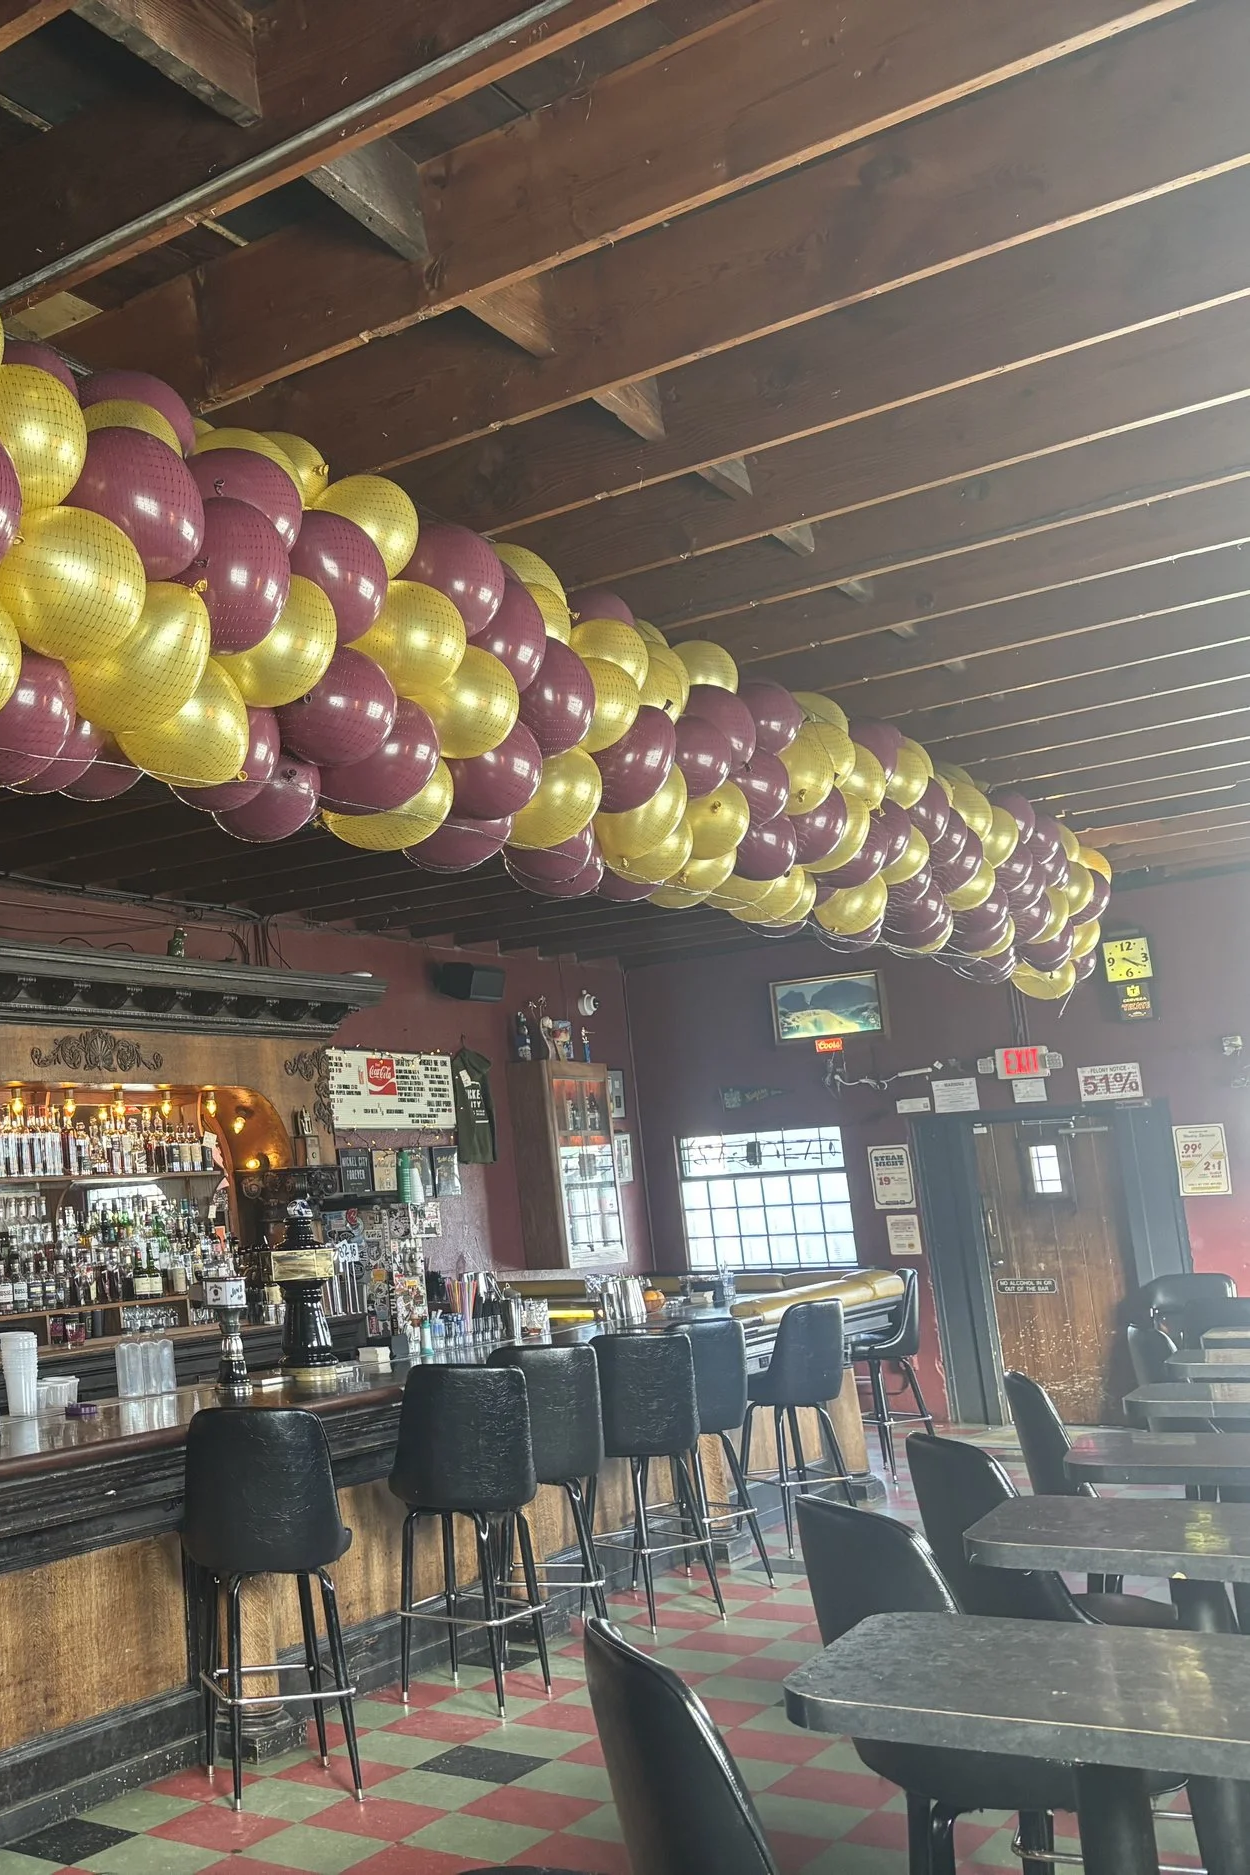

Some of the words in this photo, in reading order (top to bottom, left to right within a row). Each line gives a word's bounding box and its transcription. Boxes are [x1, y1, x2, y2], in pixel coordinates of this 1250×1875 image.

[1120, 941, 1133, 952] 12
[1107, 957, 1115, 967] 9
[1141, 952, 1149, 962] 3
[1125, 967, 1134, 978] 6
[1004, 1048, 1039, 1075] EXIT
[1090, 1067, 1109, 1075] FELONY
[1109, 1065, 1127, 1073] NOTICE
[1083, 1071, 1140, 1096] 51%
[342, 1157, 357, 1166] NICKEL
[358, 1156, 368, 1166] CITY
[873, 1154, 904, 1162] STEAK
[346, 1169, 366, 1180] FOREVER
